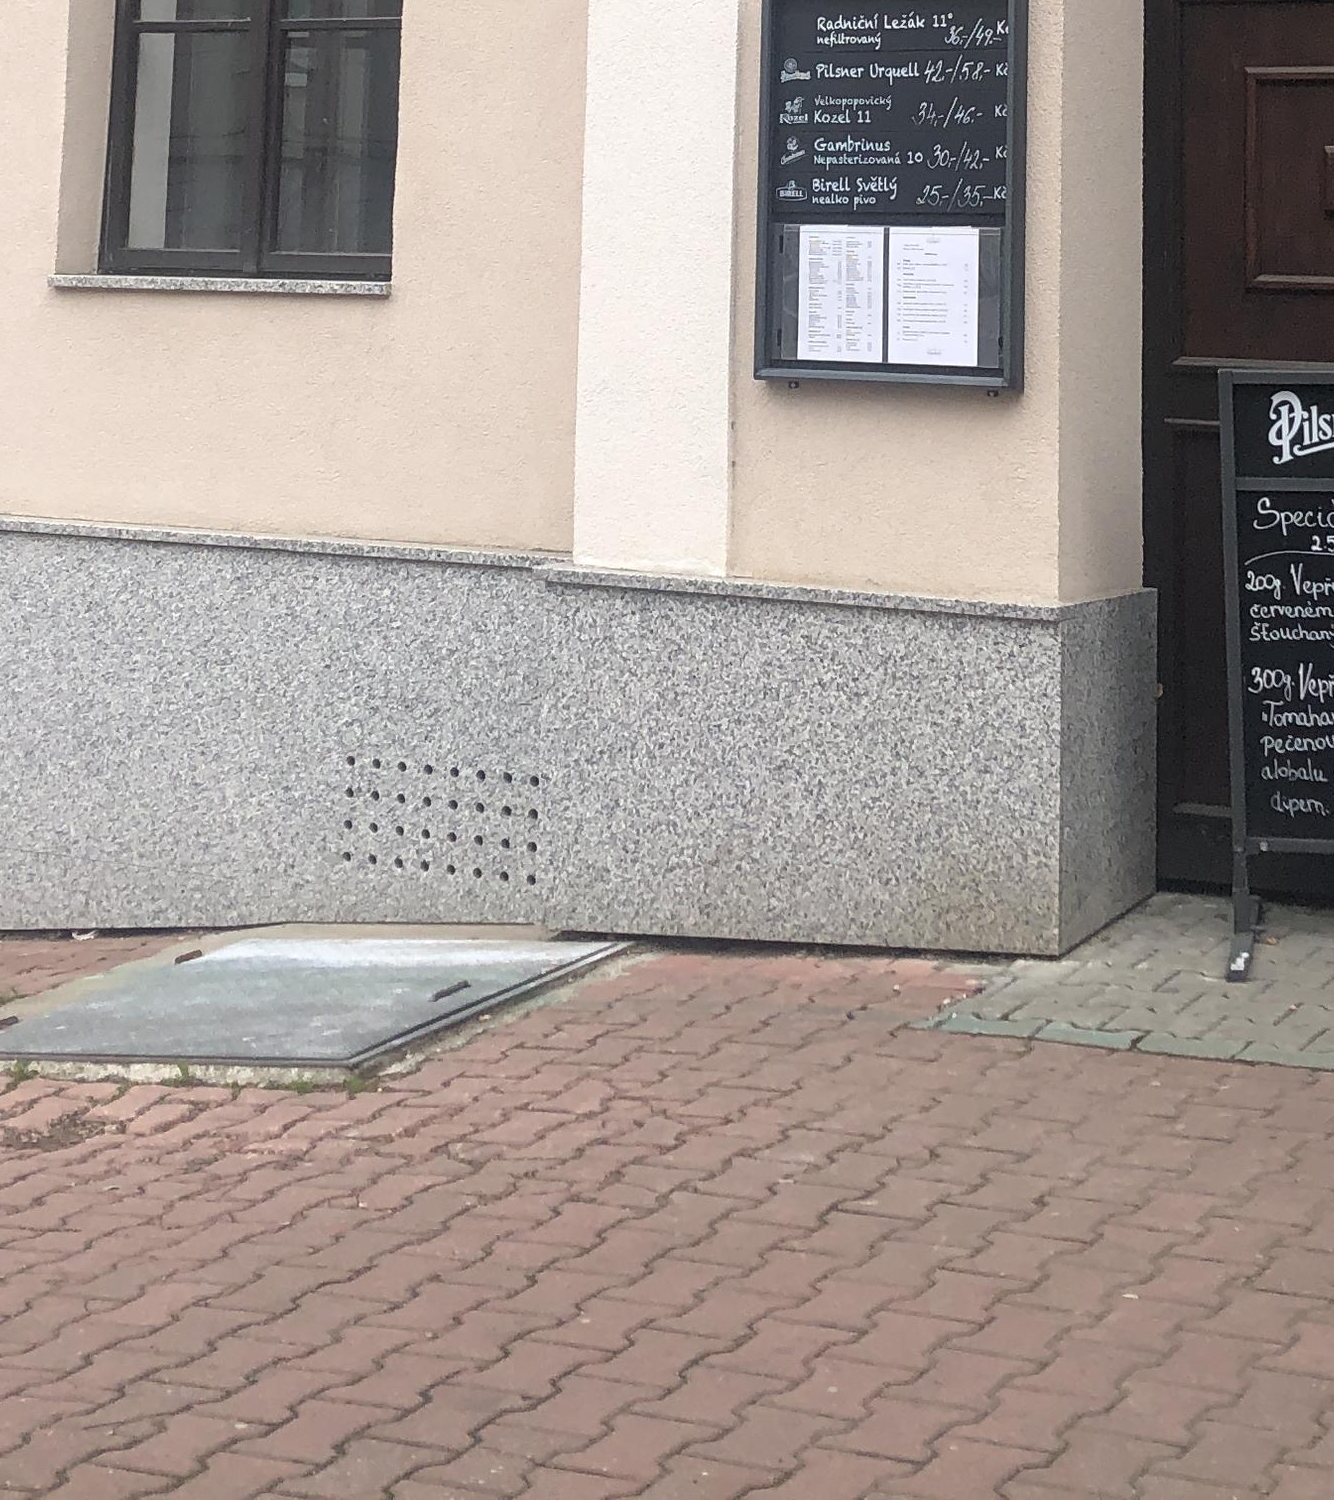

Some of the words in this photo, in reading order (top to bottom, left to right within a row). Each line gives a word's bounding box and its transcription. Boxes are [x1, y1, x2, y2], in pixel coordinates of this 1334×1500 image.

[817, 13, 879, 32] Radniční
[884, 11, 925, 30] Ležák
[932, 12, 953, 28] 11°
[816, 31, 881, 50] nefiltrovaný
[816, 63, 864, 79] Pilsner
[869, 63, 920, 86] Urquell
[814, 94, 892, 110] Velkopopovický
[814, 109, 851, 124] Kozel
[857, 110, 871, 123] 11
[814, 134, 891, 152] Gambrinus
[813, 152, 901, 171] Nepasterizovaná
[907, 152, 923, 164] 10
[812, 177, 851, 192] Birell
[856, 177, 898, 200] Světlý
[812, 193, 849, 204] nealko
[853, 194, 876, 211] pivo
[1249, 601, 1334, 619] červeném
[1260, 758, 1329, 783] alobalu
